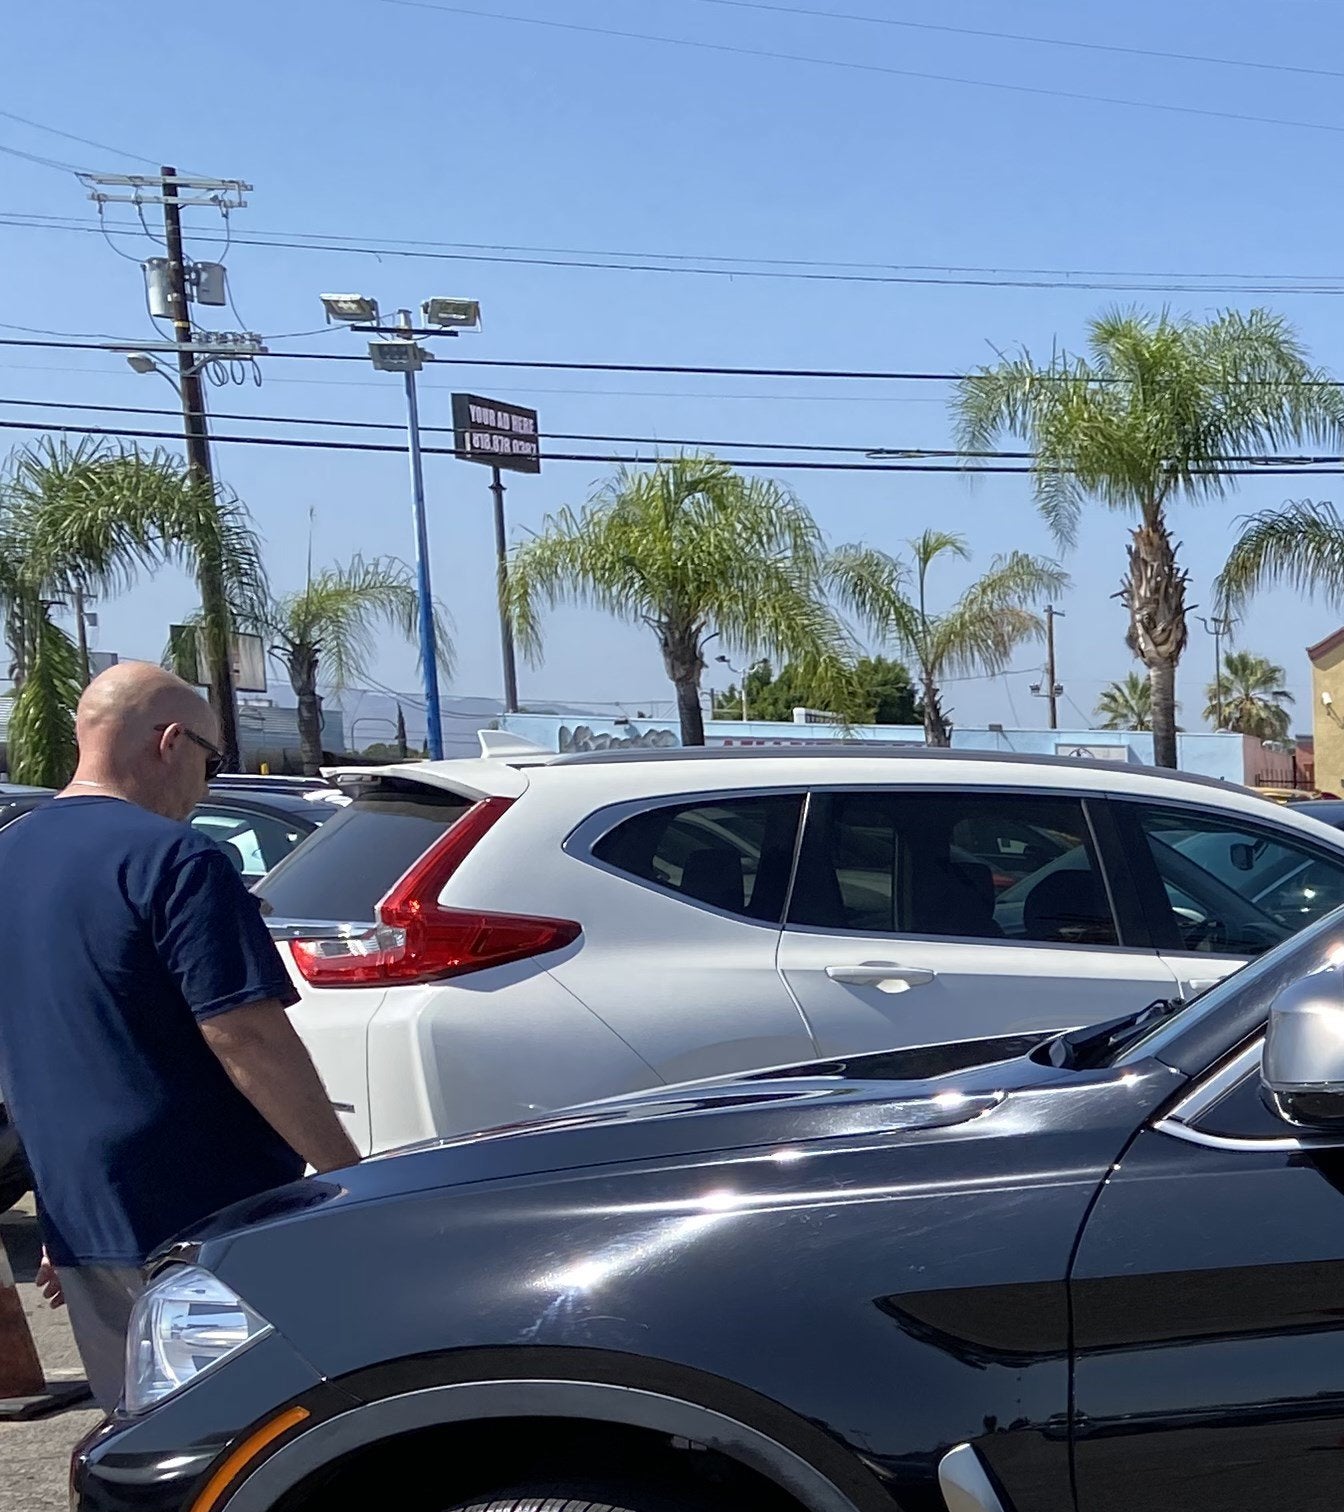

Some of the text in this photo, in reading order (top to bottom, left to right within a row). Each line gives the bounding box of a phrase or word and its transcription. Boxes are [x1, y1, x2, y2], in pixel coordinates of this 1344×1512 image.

[469, 404, 534, 434] YOUR AD HERE
